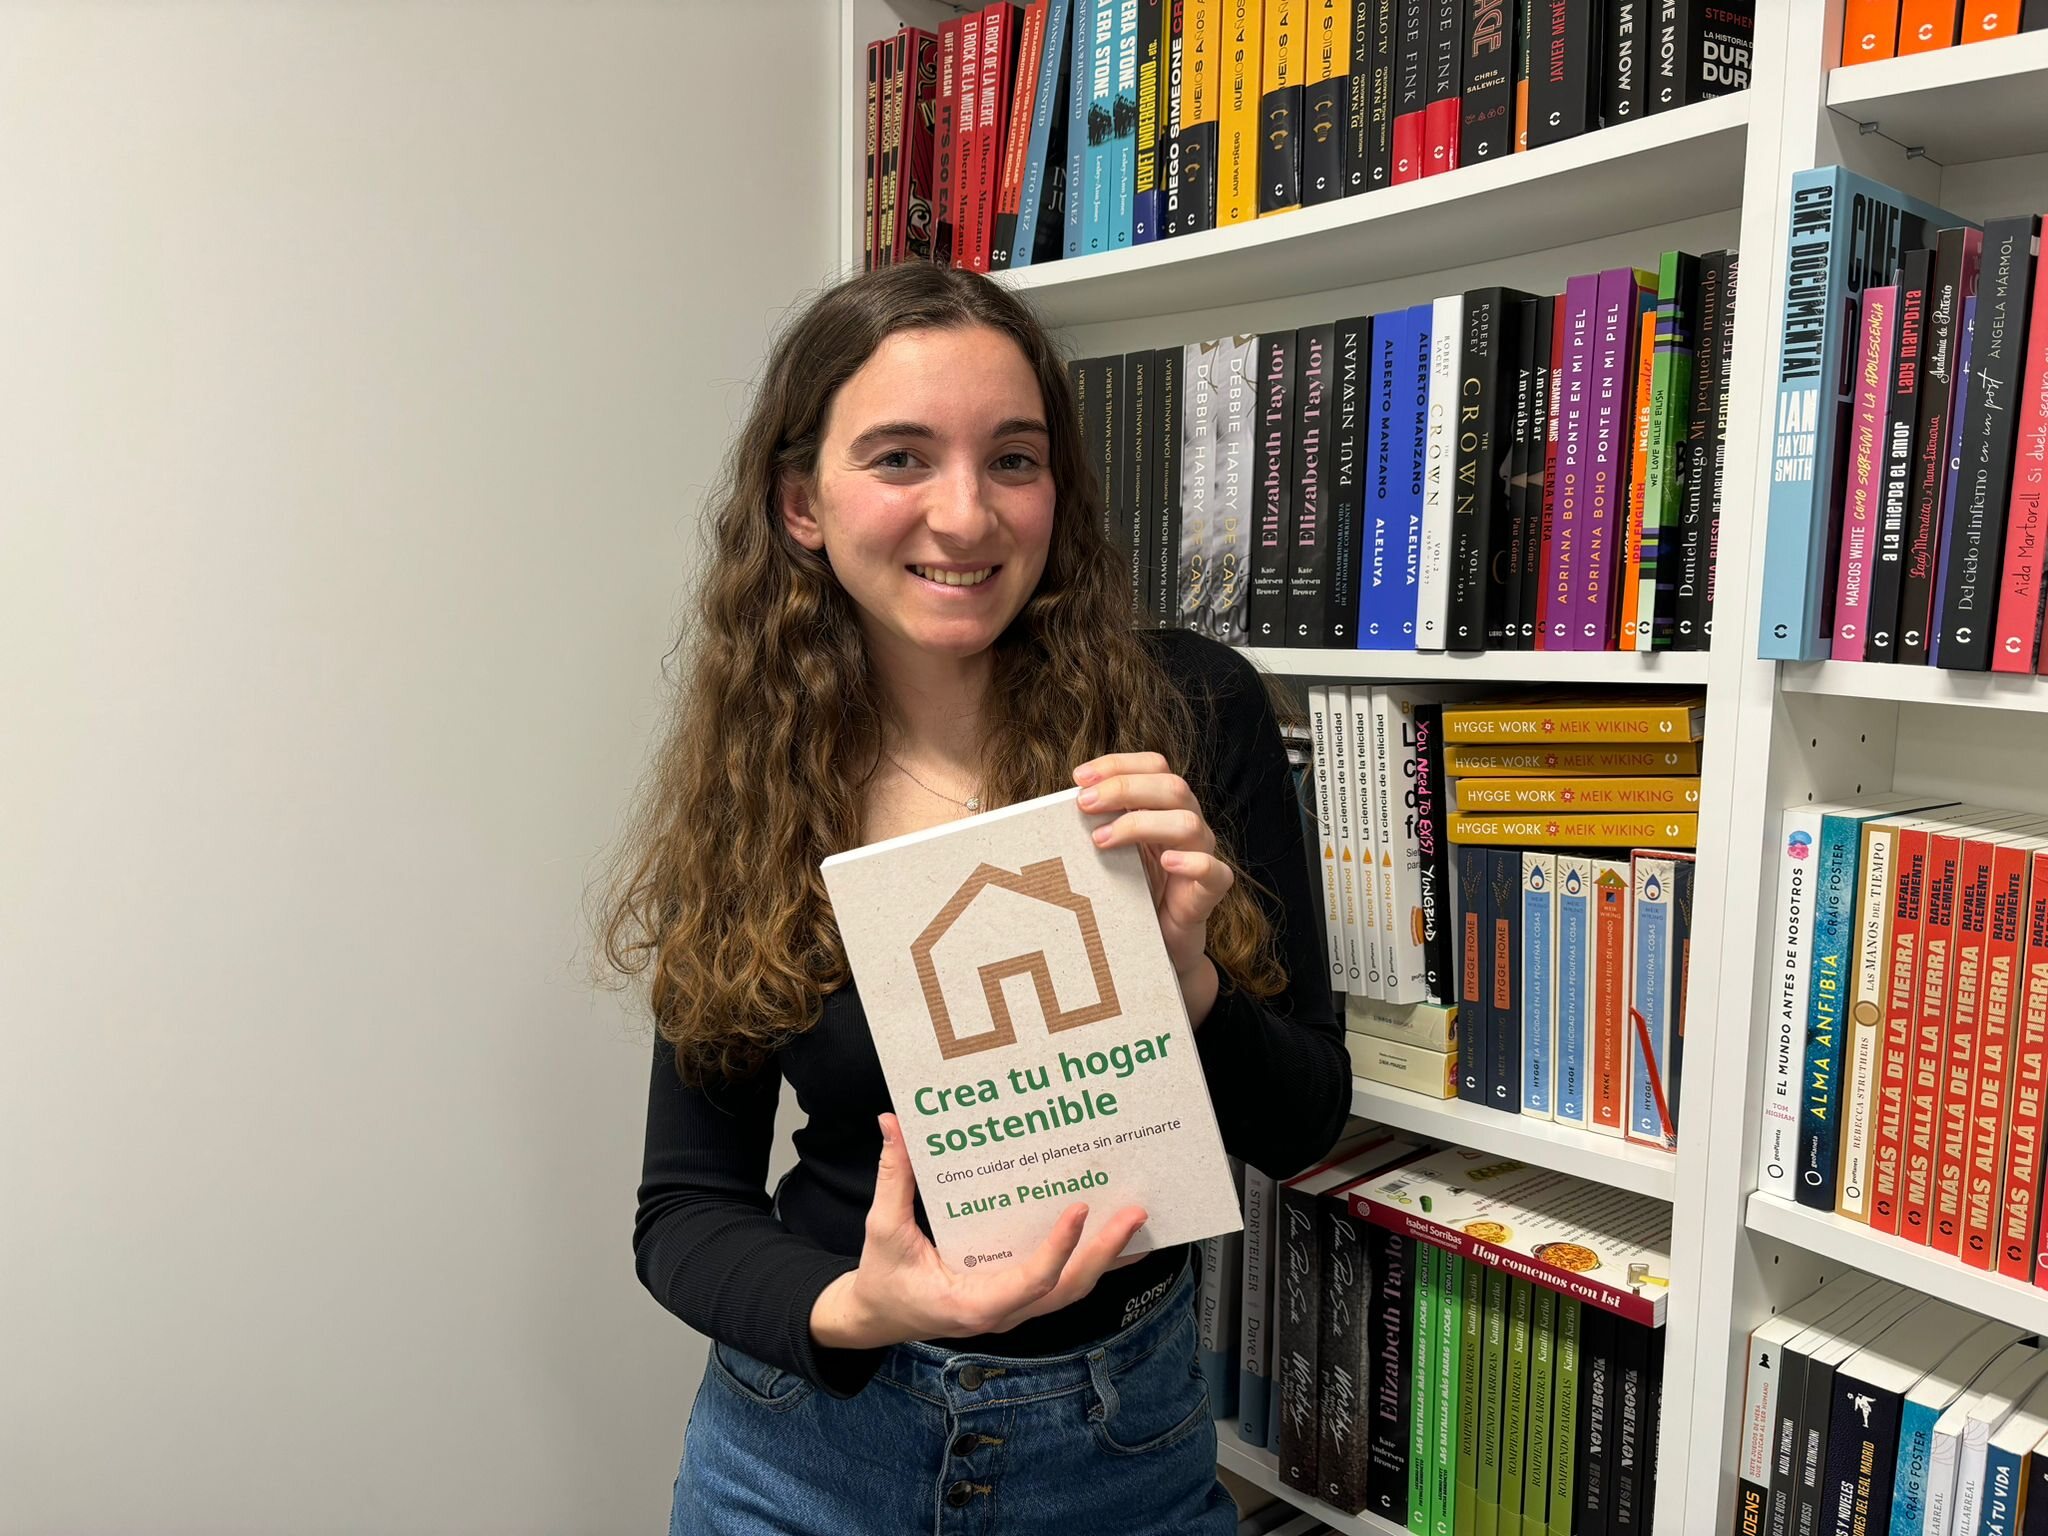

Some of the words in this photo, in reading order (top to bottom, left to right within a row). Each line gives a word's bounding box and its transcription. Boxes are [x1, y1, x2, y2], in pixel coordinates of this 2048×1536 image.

[985, 26, 999, 55] ROCK
[1096, 9, 1112, 45] ERA
[1620, 4, 1632, 37] ME
[983, 72, 996, 86] LA
[984, 57, 997, 71] DE
[1094, 46, 1110, 100] STONE
[1474, 70, 1498, 81] CHRIS
[1551, 38, 1564, 82] JAVIER
[1618, 40, 1632, 90] NOW
[980, 87, 995, 128] MUERTE
[1171, 38, 1182, 138] SIMEONE
[1467, 77, 1505, 93] SALEWICZ
[1137, 152, 1154, 193] VELVET
[1168, 143, 1180, 211] DIEGO
[1792, 185, 1832, 238] CINE
[1994, 235, 2014, 298] MÁRMOL
[1574, 309, 1586, 346] PIEL
[1606, 303, 1618, 342] PIEL
[1782, 241, 1830, 383] DOCUMENTAL
[1988, 301, 2006, 359] ÁNGELA
[1165, 358, 1173, 391] SERRAT
[1304, 338, 1324, 423] Taylor
[1342, 332, 1357, 429] NEWMAN
[1382, 339, 1394, 412] ALBERTO
[1416, 333, 1428, 407] ALBERTO
[1572, 355, 1583, 372] MI
[1604, 351, 1615, 368] MI
[1229, 359, 1243, 433] DEBBIE
[1266, 344, 1287, 426] Taylor
[1571, 381, 1582, 402] EN
[1602, 377, 1613, 398] EN
[1655, 390, 1664, 416] EILISH
[1597, 406, 1611, 463] PONTE
[1654, 419, 1662, 446] BILLIE
[1778, 389, 1817, 434] IAN
[1377, 417, 1390, 499] MANZANO
[1412, 411, 1425, 496] MANZANO
[1567, 410, 1579, 465] PONTE
[1651, 449, 1660, 470] LOVE
[1776, 434, 1814, 457] HAYDN
[1224, 442, 1240, 510] HARRY
[1340, 436, 1353, 486] PAUL
[1651, 474, 1658, 488] WE
[1775, 457, 1813, 482] SMITH
[1262, 432, 1281, 547] Elizabeth
[1299, 429, 1319, 546] Elizabeth
[1563, 473, 1575, 520] BOHO
[1594, 472, 1606, 518] BOHO
[1684, 446, 1708, 524] Santiago
[1968, 469, 1988, 528] infierno
[1223, 516, 1236, 545] DE
[1850, 525, 1865, 559] WHITE
[1967, 531, 1981, 544] al
[2016, 492, 2040, 558] Martorell
[1372, 518, 1385, 588] ALELUYA
[1406, 514, 1419, 586] ALELUYA
[1558, 528, 1572, 604] ADRIANA
[1588, 527, 1602, 603] ADRIANA
[1679, 531, 1698, 597] Daniela
[1963, 548, 1979, 583] cielo
[1221, 553, 1236, 609] CARA
[1846, 559, 1863, 607] MARCOS
[1958, 586, 1974, 610] Del
[2012, 566, 2032, 596] Aida
[1356, 713, 1365, 758] felicidad
[1376, 714, 1384, 760] felicidad
[1454, 721, 1495, 733] HYGGE
[1500, 721, 1537, 733] WORK
[1560, 721, 1590, 733] MEIK
[1596, 721, 1649, 733] WIKING
[1358, 760, 1366, 770] la
[1359, 772, 1366, 785] de
[1379, 762, 1385, 771] la
[1379, 774, 1386, 787] de
[1360, 787, 1368, 825] ciencia
[1380, 790, 1388, 828] ciencia
[1467, 791, 1511, 802] HYGGE
[1516, 790, 1556, 802] WORK
[1580, 790, 1613, 802] MEIK
[1618, 790, 1674, 802] WIKING
[1362, 827, 1369, 841] La
[1382, 830, 1389, 843] La
[1457, 823, 1498, 834] HYGGE
[1503, 823, 1541, 834] WORK
[1564, 824, 1596, 836] MEIK
[1601, 824, 1655, 837] WIKING
[1830, 843, 1845, 891] FOSTER
[1870, 842, 1885, 898] TIEMPO
[1908, 854, 1923, 920] CLEMENTE
[1788, 867, 1803, 945] NOSOTROS
[1826, 895, 1840, 936] CRAIG
[1872, 901, 1881, 919] DEL
[1898, 873, 1910, 919] RAFAEL
[1929, 878, 1942, 925] RAFAEL
[1940, 860, 1955, 926] CLEMENTE
[1962, 884, 1975, 931] RAFAEL
[1973, 865, 1989, 933] CLEMENTE
[1785, 949, 1797, 969] DE
[1865, 921, 1879, 970] MANOS
[1866, 972, 1874, 991] LAS
[1892, 933, 1914, 1010] TIERRA
[1923, 939, 1946, 1017] TIERRA
[1956, 946, 1979, 1025] TIERRA
[1783, 974, 1795, 1019] ANTES
[1816, 954, 1839, 1048] ANFIBIA
[1778, 1023, 1792, 1075] MUNDO
[1890, 1018, 1907, 1045] LA
[1921, 1026, 1938, 1053] LA
[1952, 1033, 1971, 1061] LA
[914, 1078, 1000, 1116] Crea
[1007, 1065, 1050, 1095] tu
[1057, 1032, 1171, 1078] hogar
[1857, 1037, 1869, 1099] STRUTHERS
[1887, 1048, 1905, 1080] DE
[1917, 1056, 1936, 1088] DE
[1950, 1065, 1969, 1096] DE
[1777, 1080, 1787, 1096] EL
[1811, 1058, 1831, 1120] ALMA
[925, 1089, 1118, 1156] sostenible
[1853, 1102, 1864, 1149] REBECCA
[1881, 1086, 1902, 1142] ALLÁ
[1911, 1094, 1933, 1150] ALLÁ
[1944, 1102, 1965, 1159] ALLÁ
[936, 1169, 974, 1184] Cómo
[977, 1159, 1016, 1176] cuidar
[1019, 1151, 1039, 1167] del
[1042, 1142, 1090, 1164] planeta
[1093, 1136, 1112, 1149] sin
[1115, 1118, 1182, 1144] arruinarte
[1876, 1145, 1897, 1196] MÁS
[945, 1193, 1012, 1219] Laura
[1016, 1169, 1109, 1204] Peinado
[1906, 1154, 1928, 1206] MÁS
[1937, 1163, 1960, 1215] MÁS
[1406, 1216, 1429, 1233] Isabel
[1429, 1226, 1462, 1245] Sorribas
[977, 1250, 1013, 1264] Planeta
[1472, 1243, 1499, 1266] Hoy
[1502, 1254, 1568, 1288] comemos
[1570, 1277, 1597, 1300] con
[1601, 1289, 1621, 1309] Isi
[1562, 1378, 1572, 1432] BARRERAS
[1780, 1418, 1794, 1455] TRONCHONI
[1860, 1441, 1875, 1476] MADRID
[1558, 1433, 1571, 1498] ROMPIENDO
[1779, 1454, 1790, 1476] NADIA
[1857, 1477, 1871, 1498] REAL
